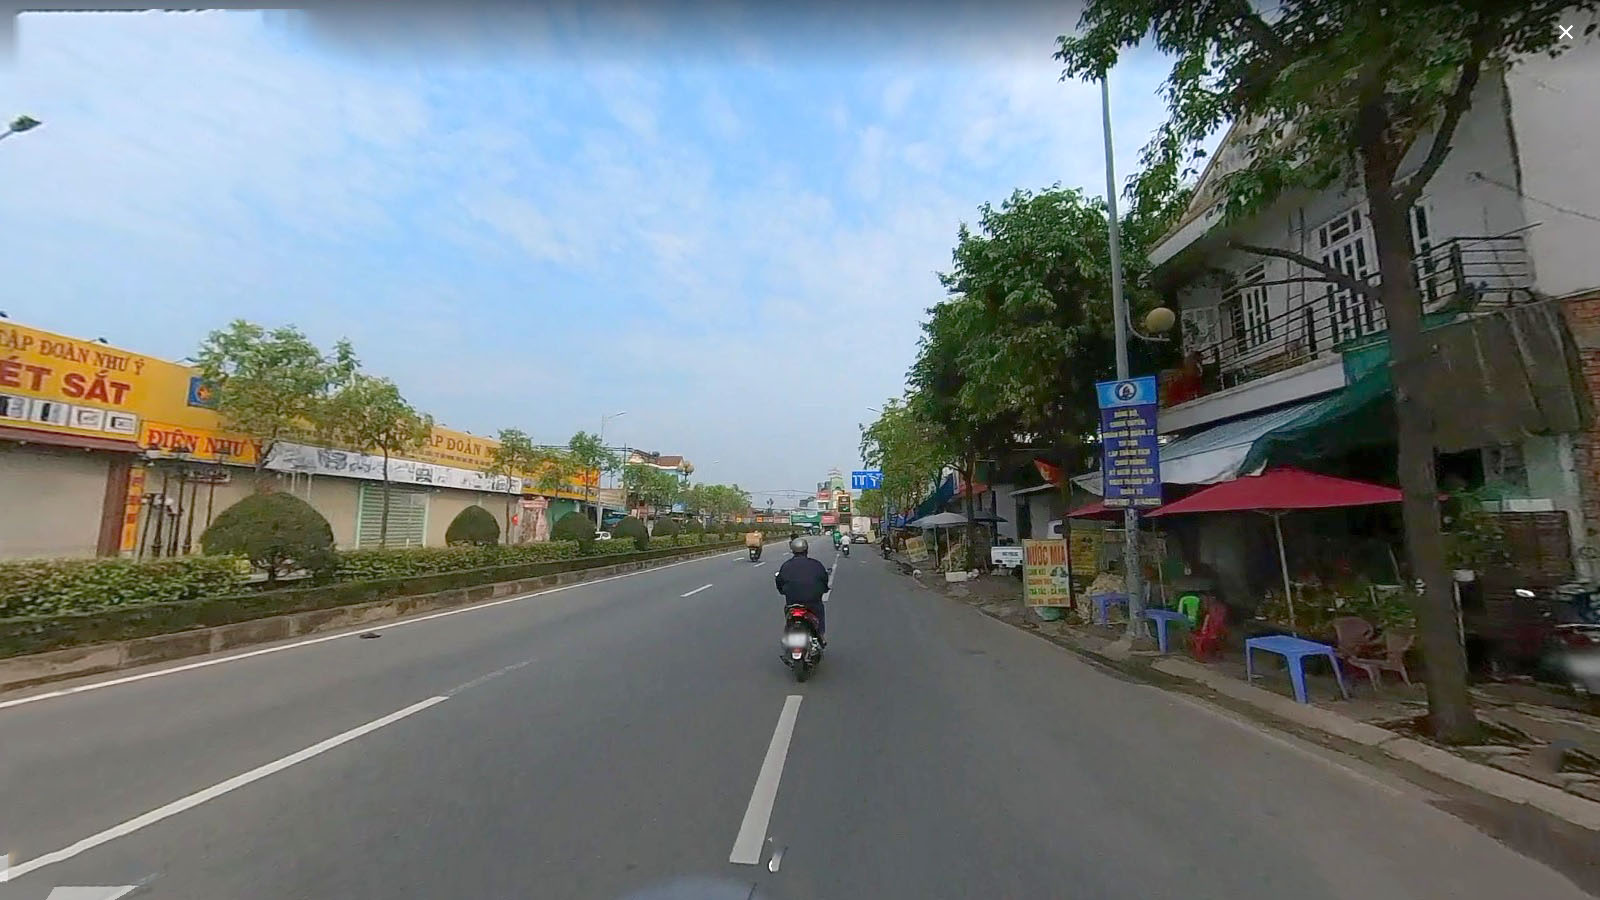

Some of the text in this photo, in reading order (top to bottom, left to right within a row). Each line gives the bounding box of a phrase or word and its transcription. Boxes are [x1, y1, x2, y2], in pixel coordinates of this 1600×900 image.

[40, 340, 90, 363] ĐOÀN
[94, 351, 131, 372] NHƯ
[134, 358, 145, 376] Ý
[61, 368, 131, 405] SẮT
[203, 437, 248, 458] NHƯ
[446, 438, 481, 456] ĐOÀN
[1026, 544, 1048, 566] NƯỚC
